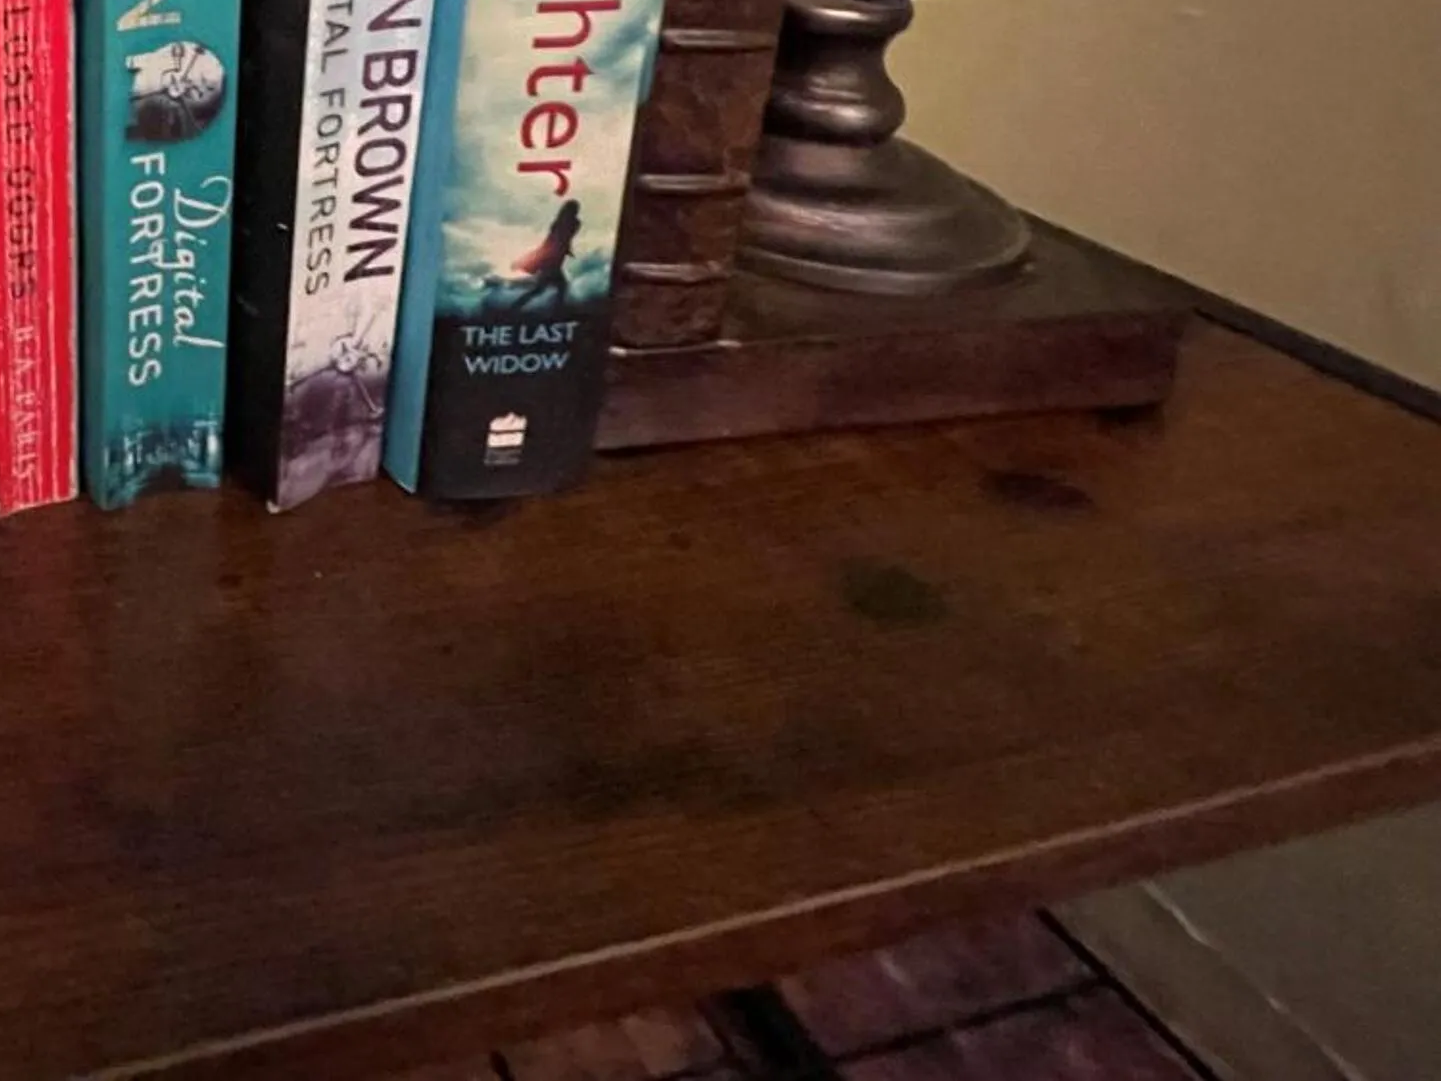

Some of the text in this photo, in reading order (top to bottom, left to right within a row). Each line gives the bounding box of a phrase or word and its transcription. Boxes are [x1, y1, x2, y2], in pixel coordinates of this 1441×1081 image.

[305, 88, 346, 296] FORTRESS
[343, 49, 420, 283] BROWN
[129, 152, 166, 386] FORTRESS
[152, 176, 233, 348] Digital
[461, 321, 578, 347] THE LAST
[464, 352, 570, 375] WIDOW
